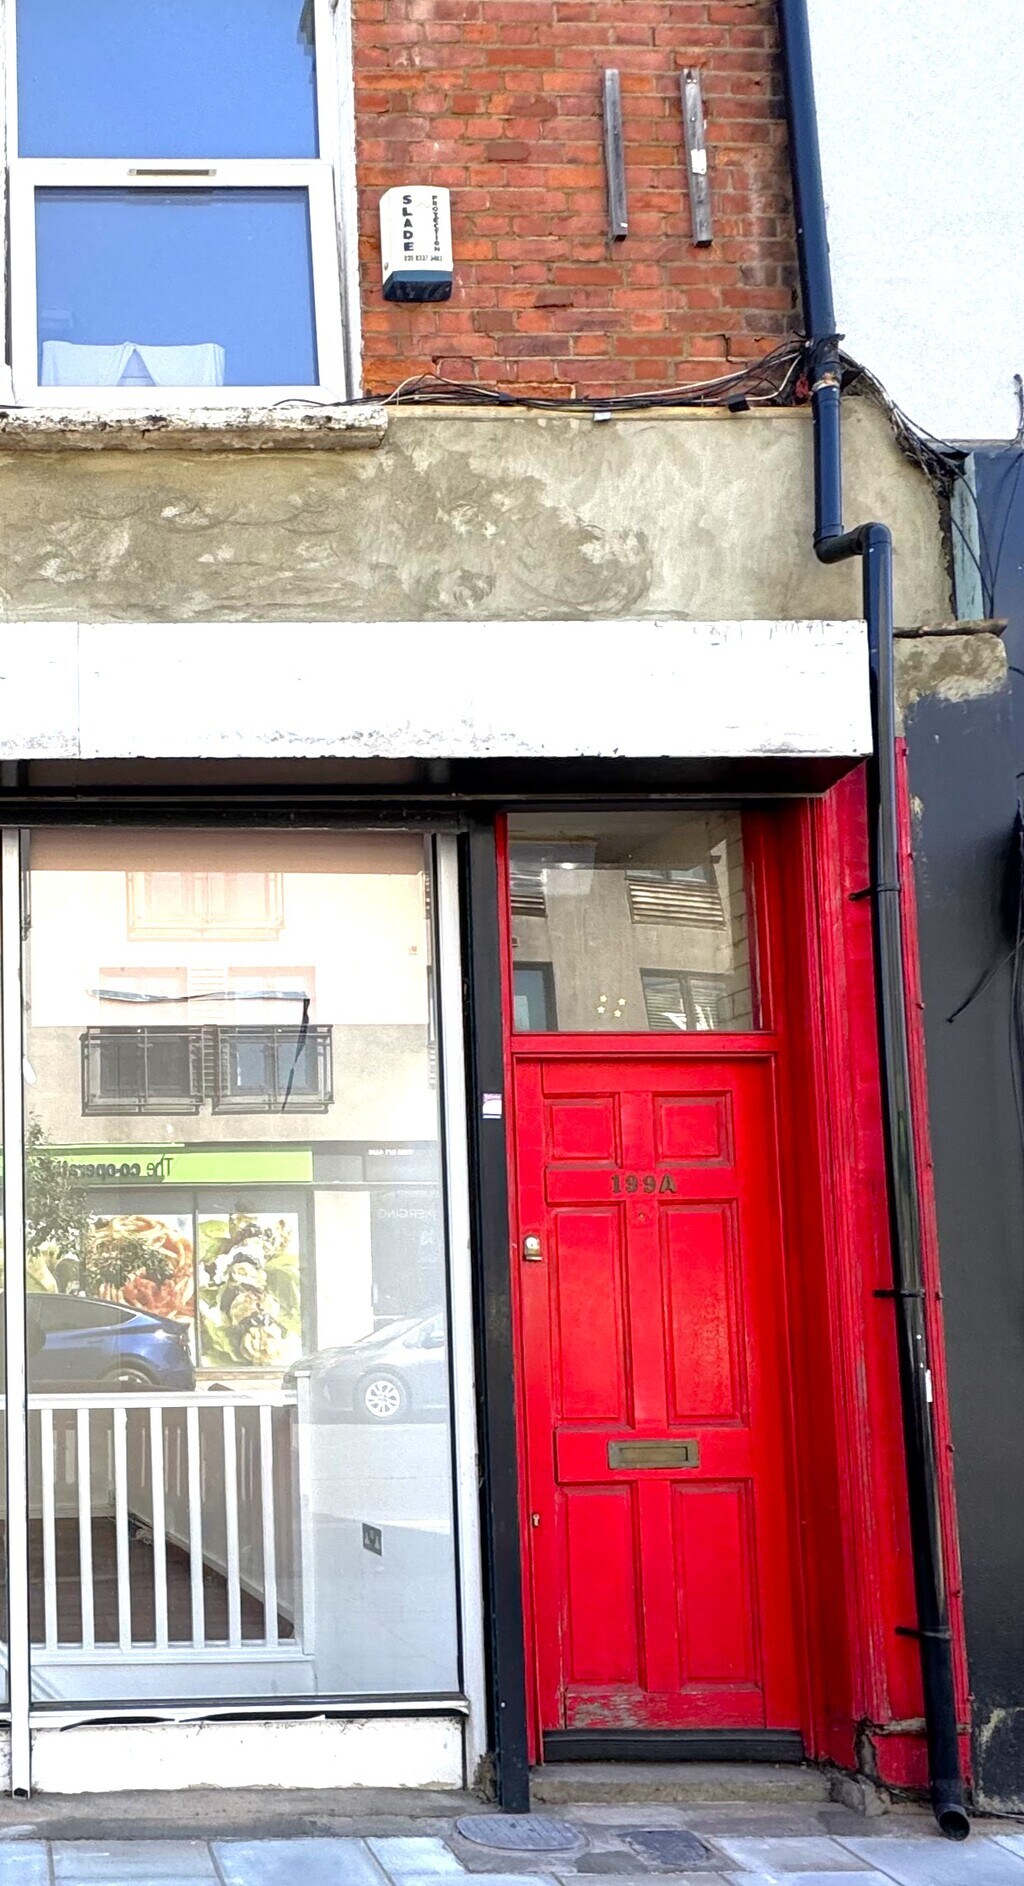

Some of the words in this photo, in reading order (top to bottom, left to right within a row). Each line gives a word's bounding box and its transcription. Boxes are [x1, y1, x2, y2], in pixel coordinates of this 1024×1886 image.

[402, 194, 414, 252] SLADE
[432, 195, 440, 252] PROTECTION
[611, 1173, 677, 1194] 199A
